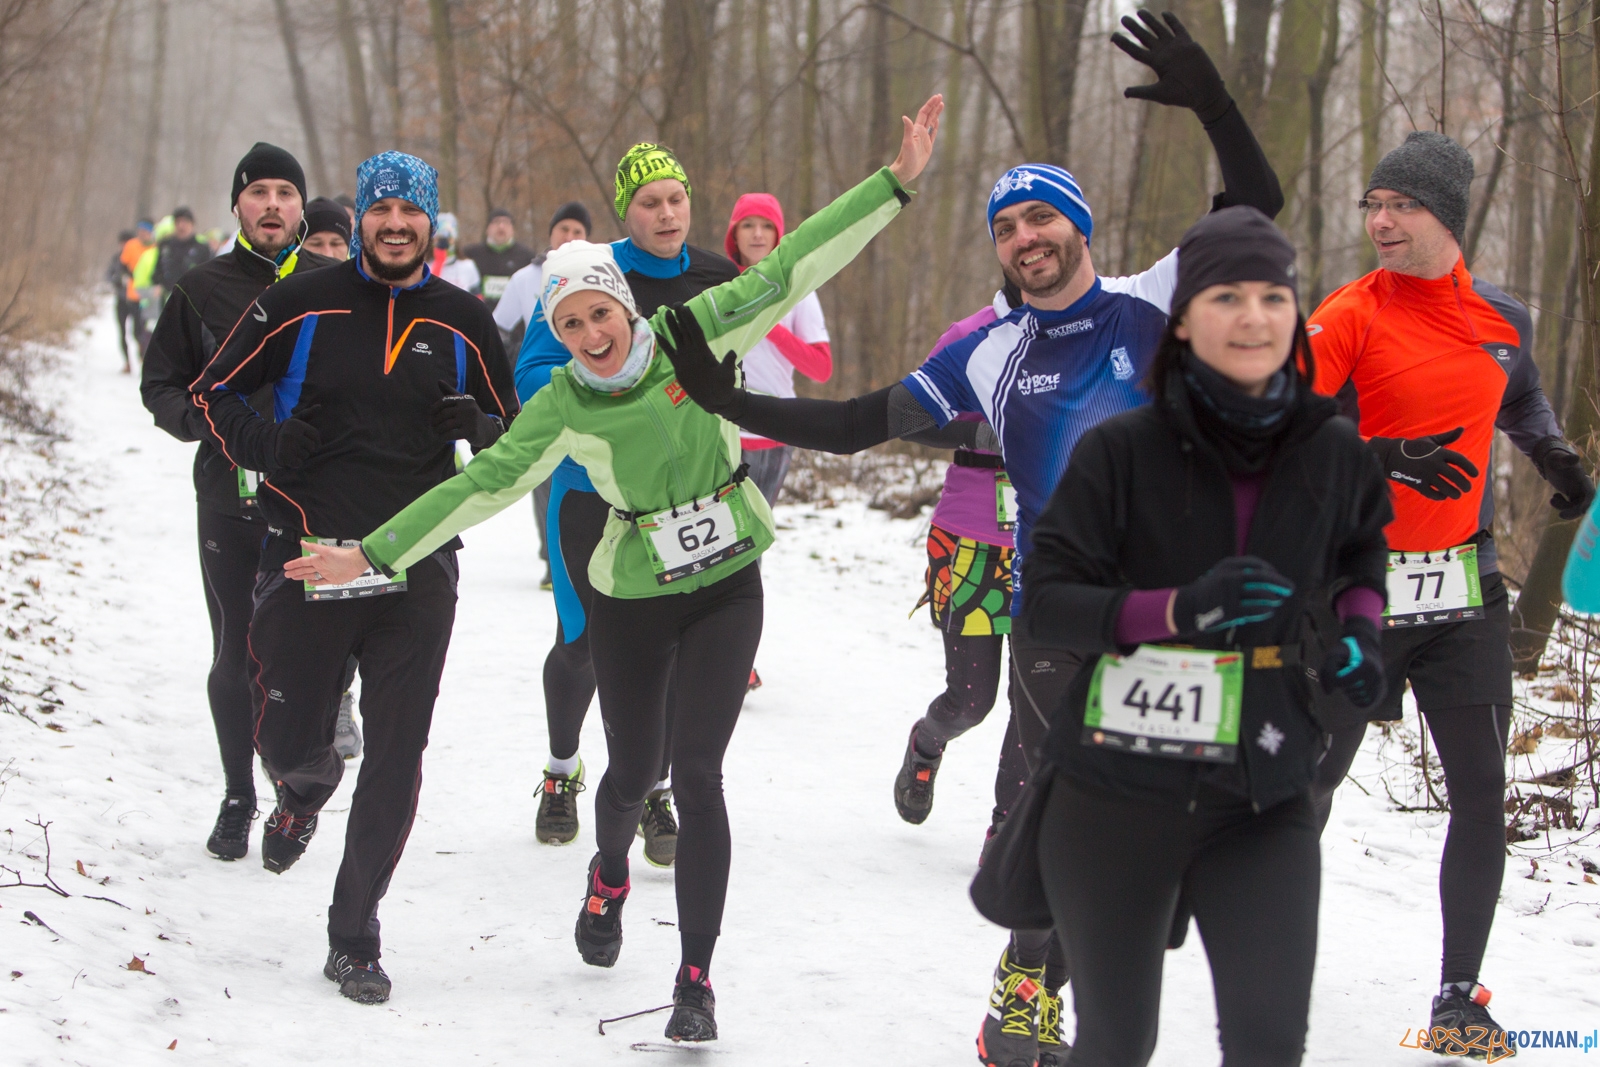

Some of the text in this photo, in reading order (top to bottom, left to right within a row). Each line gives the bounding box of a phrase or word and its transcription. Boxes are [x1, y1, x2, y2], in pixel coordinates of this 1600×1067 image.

[677, 517, 720, 552] 62
[1407, 570, 1445, 602] 77
[1416, 602, 1444, 612] STACHU
[1122, 678, 1204, 723] 441
